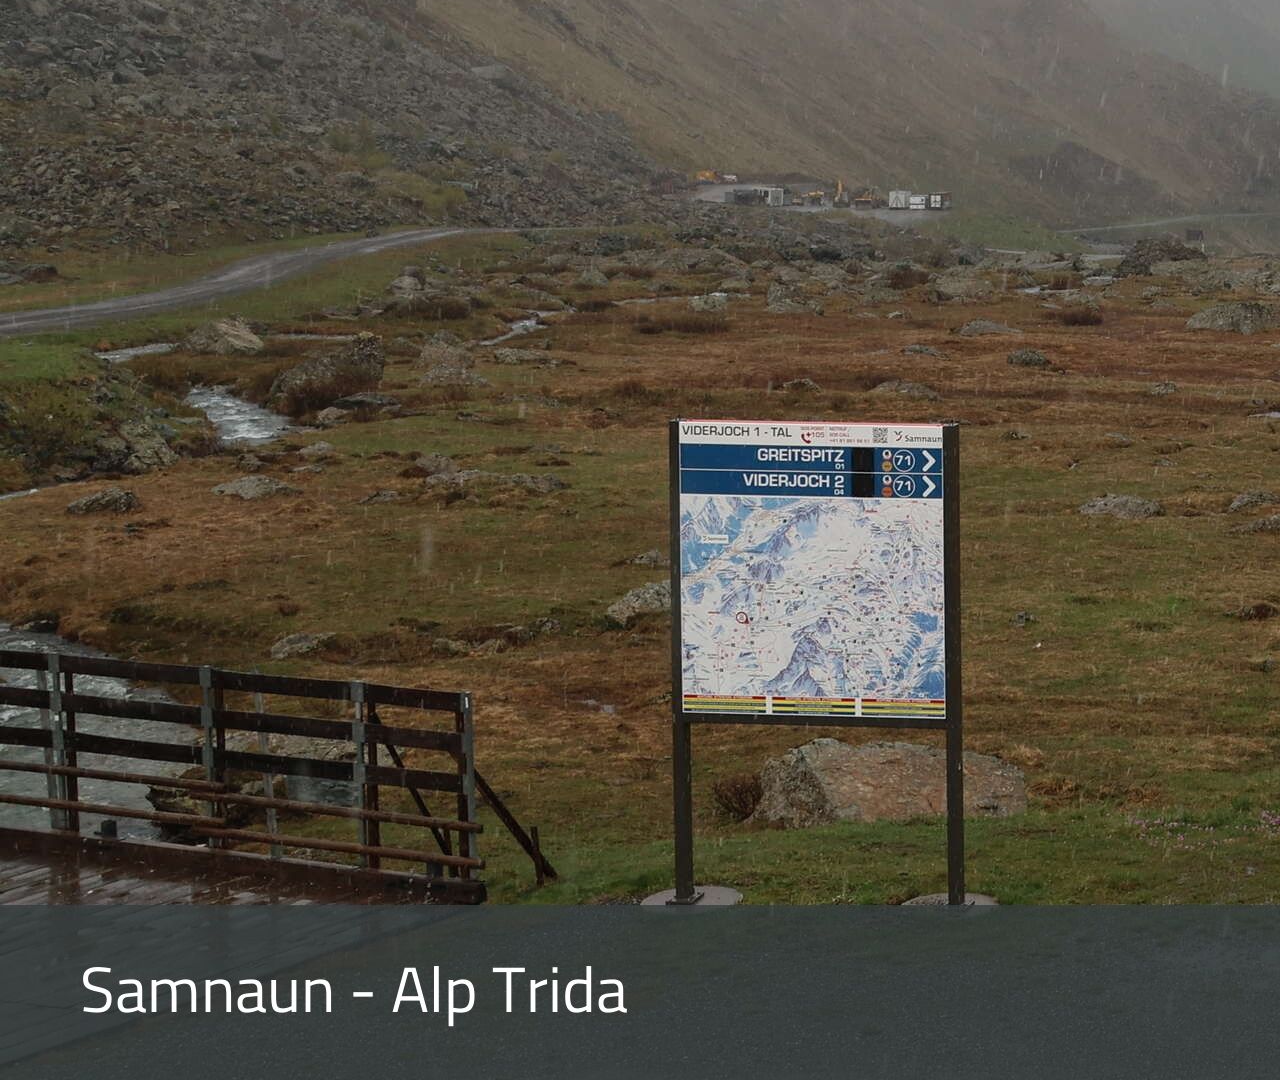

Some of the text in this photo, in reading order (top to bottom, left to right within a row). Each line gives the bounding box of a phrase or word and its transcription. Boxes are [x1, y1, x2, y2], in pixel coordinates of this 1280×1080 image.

[682, 425, 750, 437] VIDERJOCH
[753, 426, 760, 437] 1
[771, 426, 792, 438] TAL
[904, 434, 943, 443] Samnaun
[757, 448, 845, 463] GREITSPITZ
[895, 455, 911, 466] 71
[743, 473, 845, 488] VIDERJOCH 2
[895, 480, 911, 491] 71
